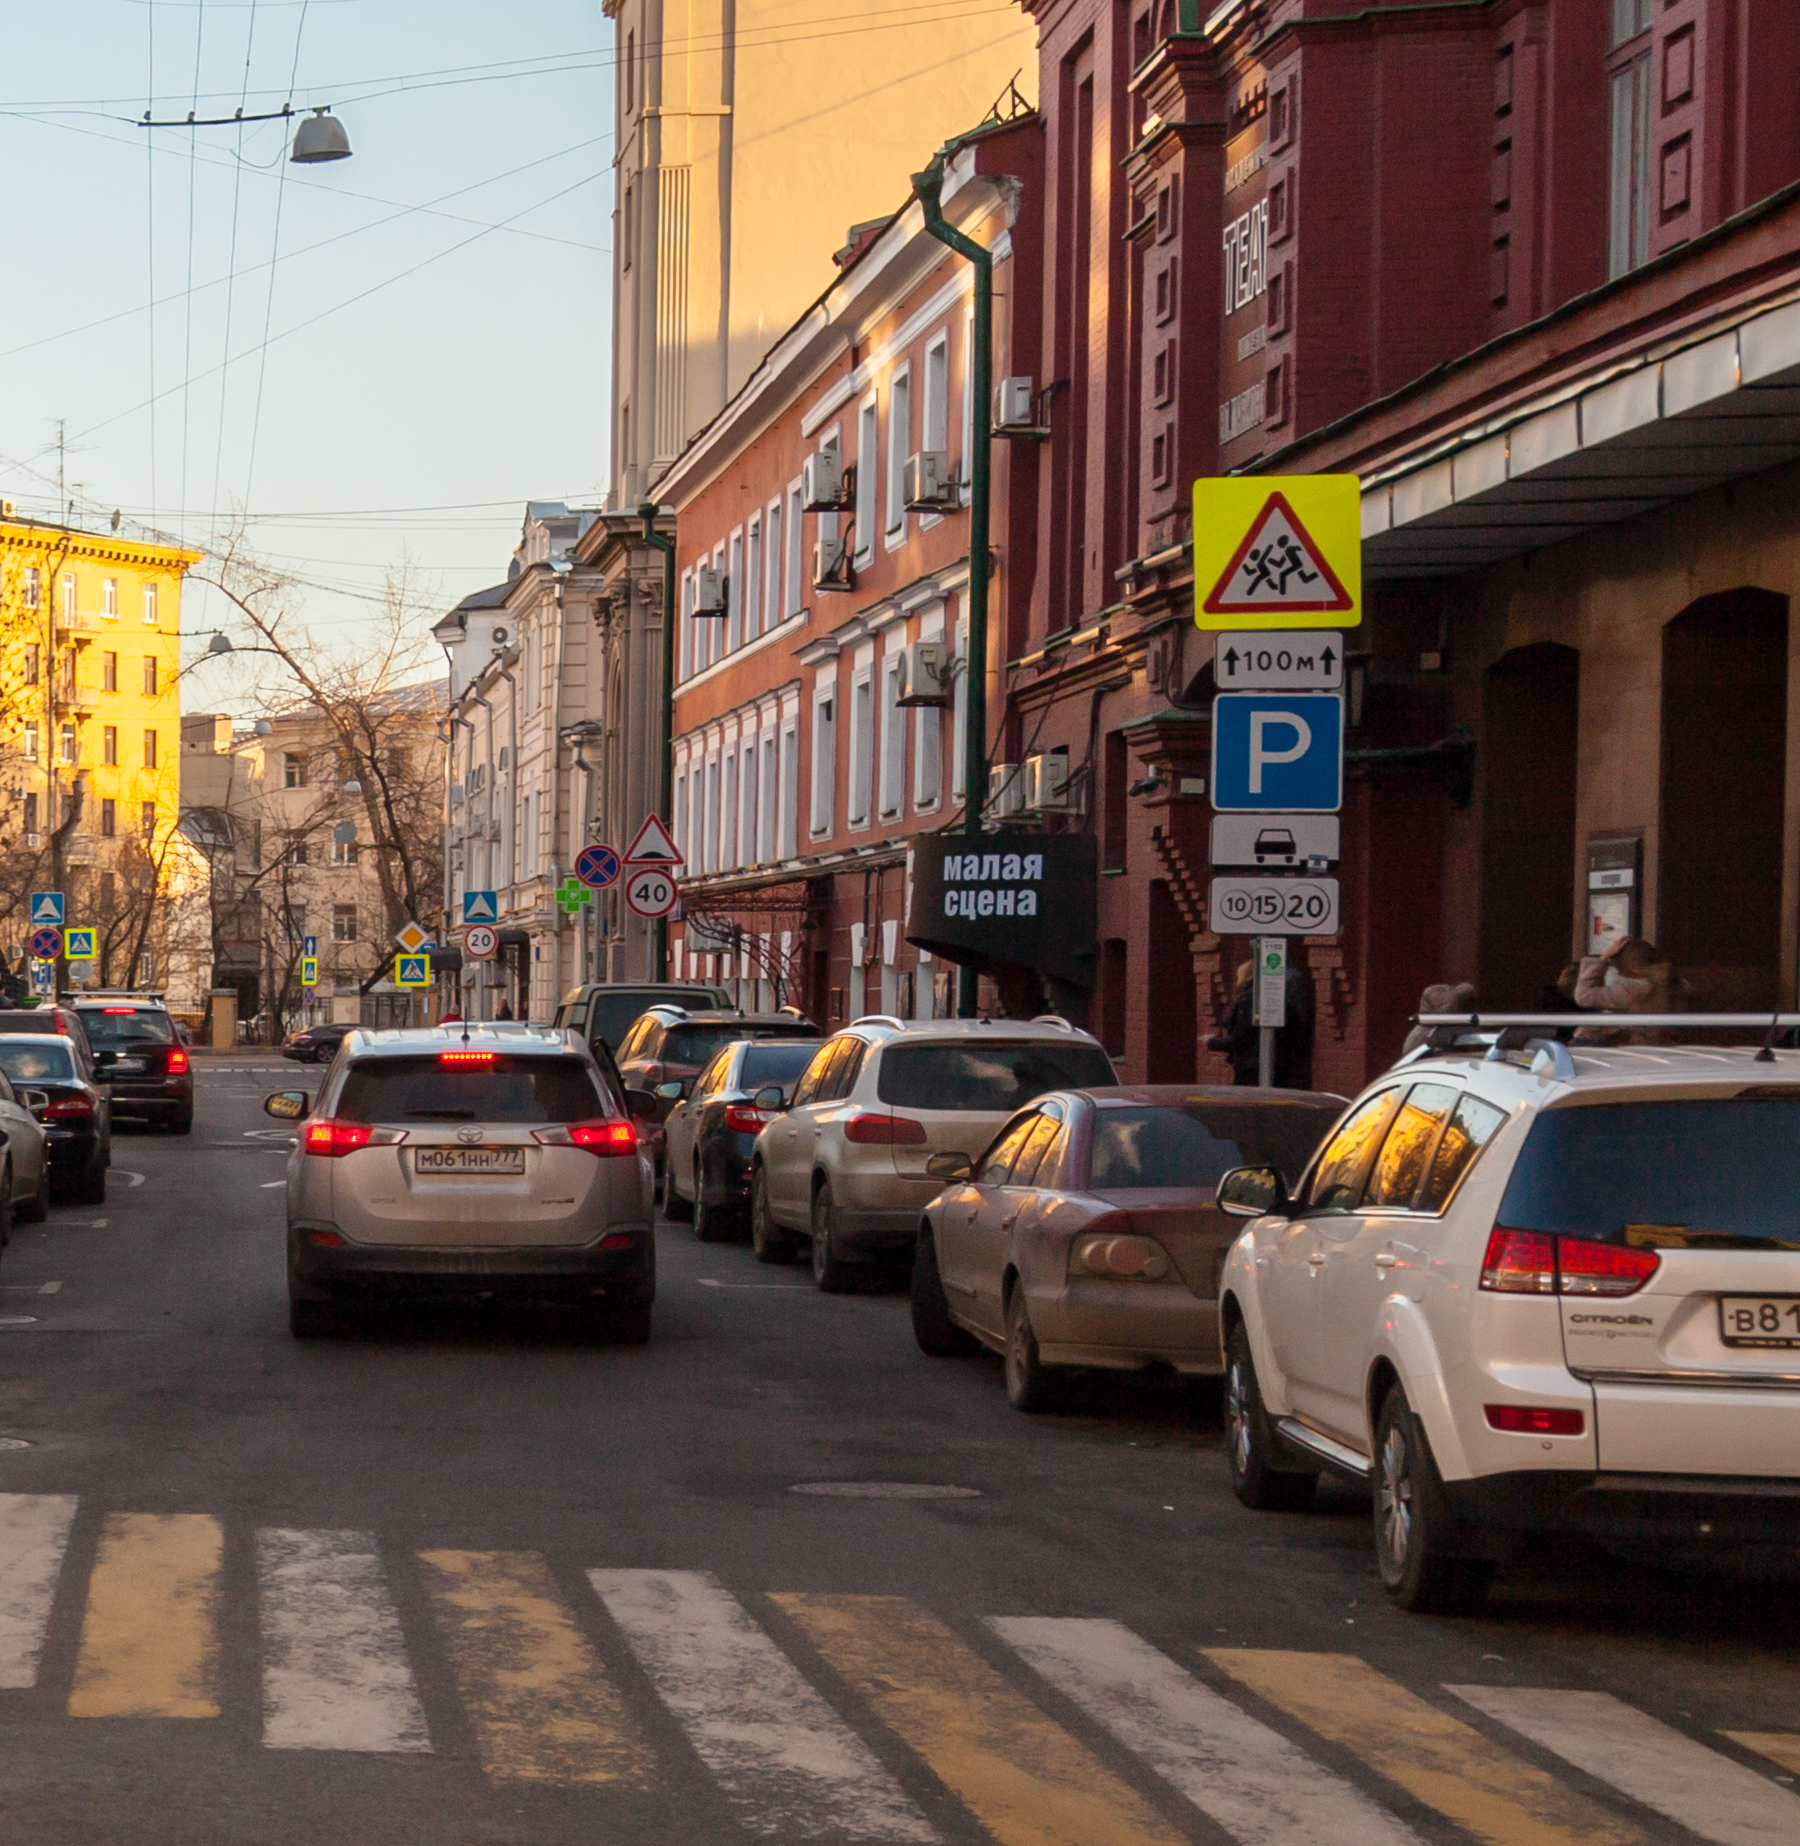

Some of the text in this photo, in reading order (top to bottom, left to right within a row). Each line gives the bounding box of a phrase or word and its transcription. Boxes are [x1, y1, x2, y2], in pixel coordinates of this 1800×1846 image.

[1249, 711, 1312, 794] P
[943, 853, 1044, 881] малая
[635, 883, 668, 903] 40
[944, 889, 1038, 921] сцена
[1227, 895, 1324, 918] 10 15 20
[471, 933, 491, 947] 20
[494, 1150, 519, 1163] 777
